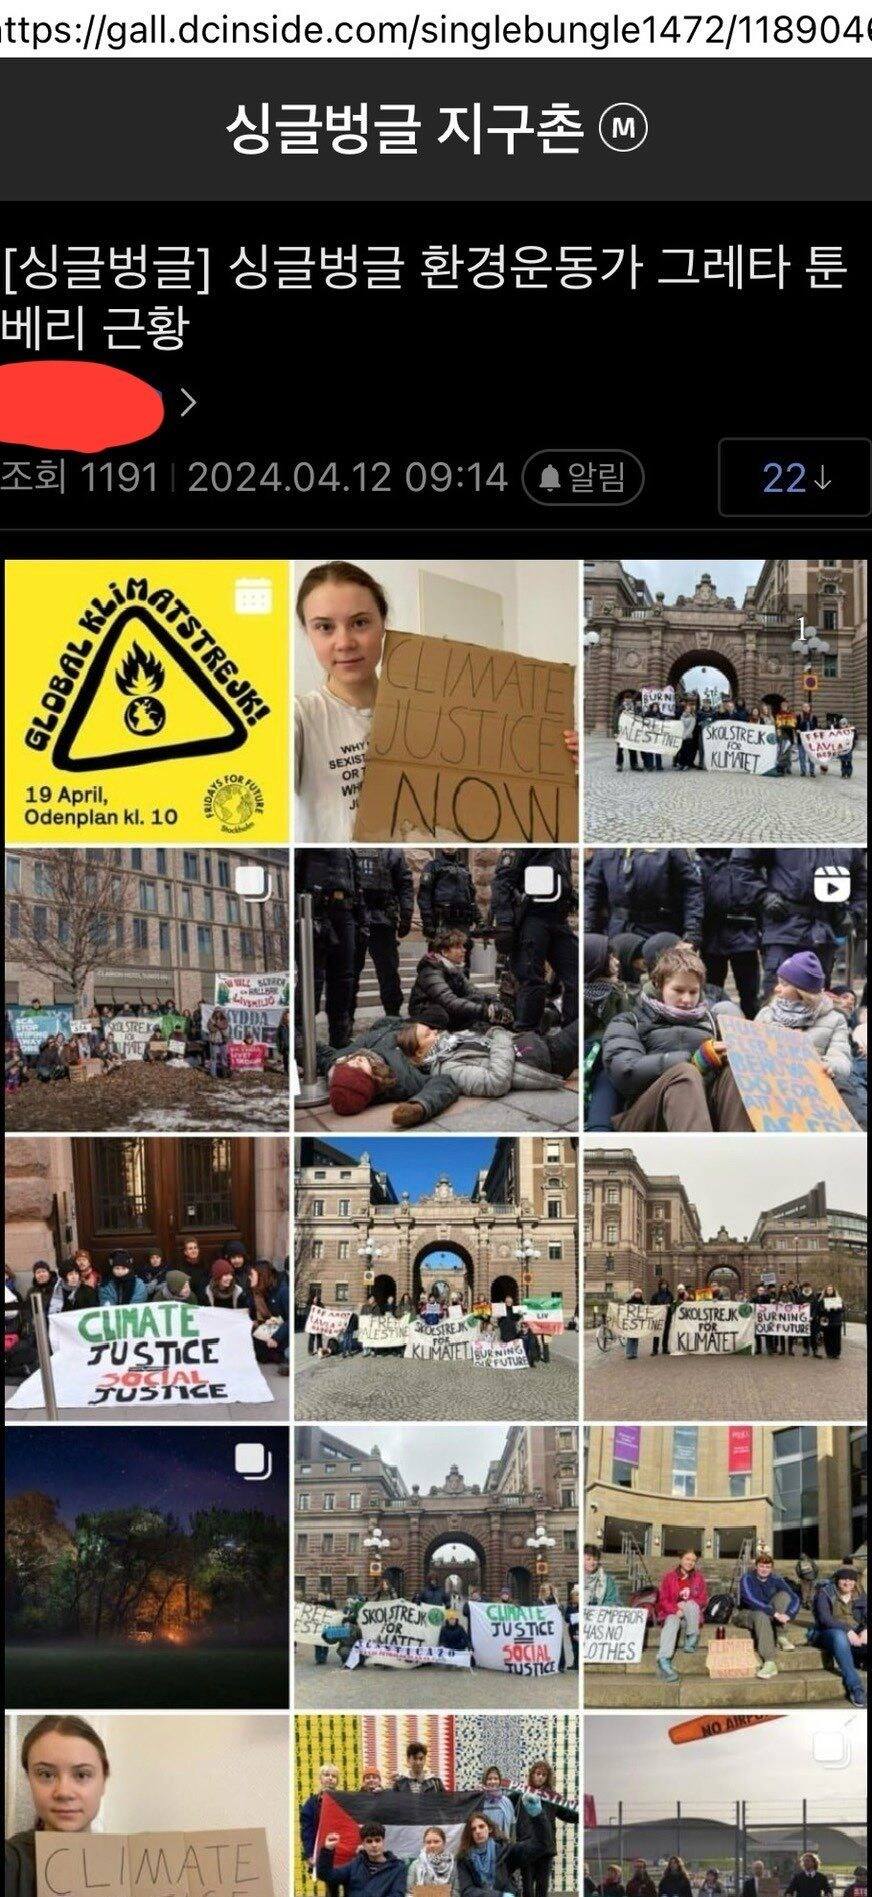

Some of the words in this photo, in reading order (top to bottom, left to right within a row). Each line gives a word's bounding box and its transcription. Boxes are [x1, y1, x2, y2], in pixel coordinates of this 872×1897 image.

[0, 14, 872, 50] ttps://gall.dcinside.com/singlebungle1472/118904
[226, 103, 421, 154] 싱글벙글
[438, 103, 584, 154] 지구촌
[6, 244, 209, 295] [싱글벙글]
[230, 244, 404, 289] 싱글벙글
[421, 244, 643, 289] 환경운동가
[658, 244, 791, 289] 그레타
[806, 246, 848, 289] 툰
[2, 306, 84, 351] 베리
[103, 306, 190, 351] 근황
[0, 458, 66, 494] 조회
[82, 462, 158, 492] 1191
[188, 462, 392, 493] 2024.04.12
[405, 462, 509, 493] 09:14
[569, 461, 624, 493] 알림
[763, 462, 806, 493] 22
[386, 639, 568, 715] CLIMATE
[25, 639, 93, 752] GLOBAL
[375, 700, 565, 776] JUSTICE
[25, 786, 51, 803] 19
[58, 786, 108, 806] April,
[204, 779, 223, 818] FRIDAYS
[224, 774, 244, 784] FOR
[245, 779, 264, 815] FUTURE
[391, 771, 560, 843] NOW
[24, 809, 118, 828] Odenplan
[124, 809, 144, 825] kl.
[152, 809, 178, 825] 10
[78, 1303, 200, 1343] CLIMATE
[678, 1307, 738, 1321] SKOLSTREJK
[757, 1311, 808, 1322] BURNING
[87, 1338, 220, 1366] JUSTICE
[87, 1383, 228, 1405] JUSTICE
[99, 1369, 210, 1388] SOCIAL
[486, 1605, 547, 1621] CLIMATE
[491, 1621, 554, 1637] JUSTICE
[606, 1625, 623, 1640] NO
[502, 1644, 551, 1663] SOCIAL
[504, 1662, 556, 1677] JUSTICE
[45, 1843, 260, 1896] CLIMATE
